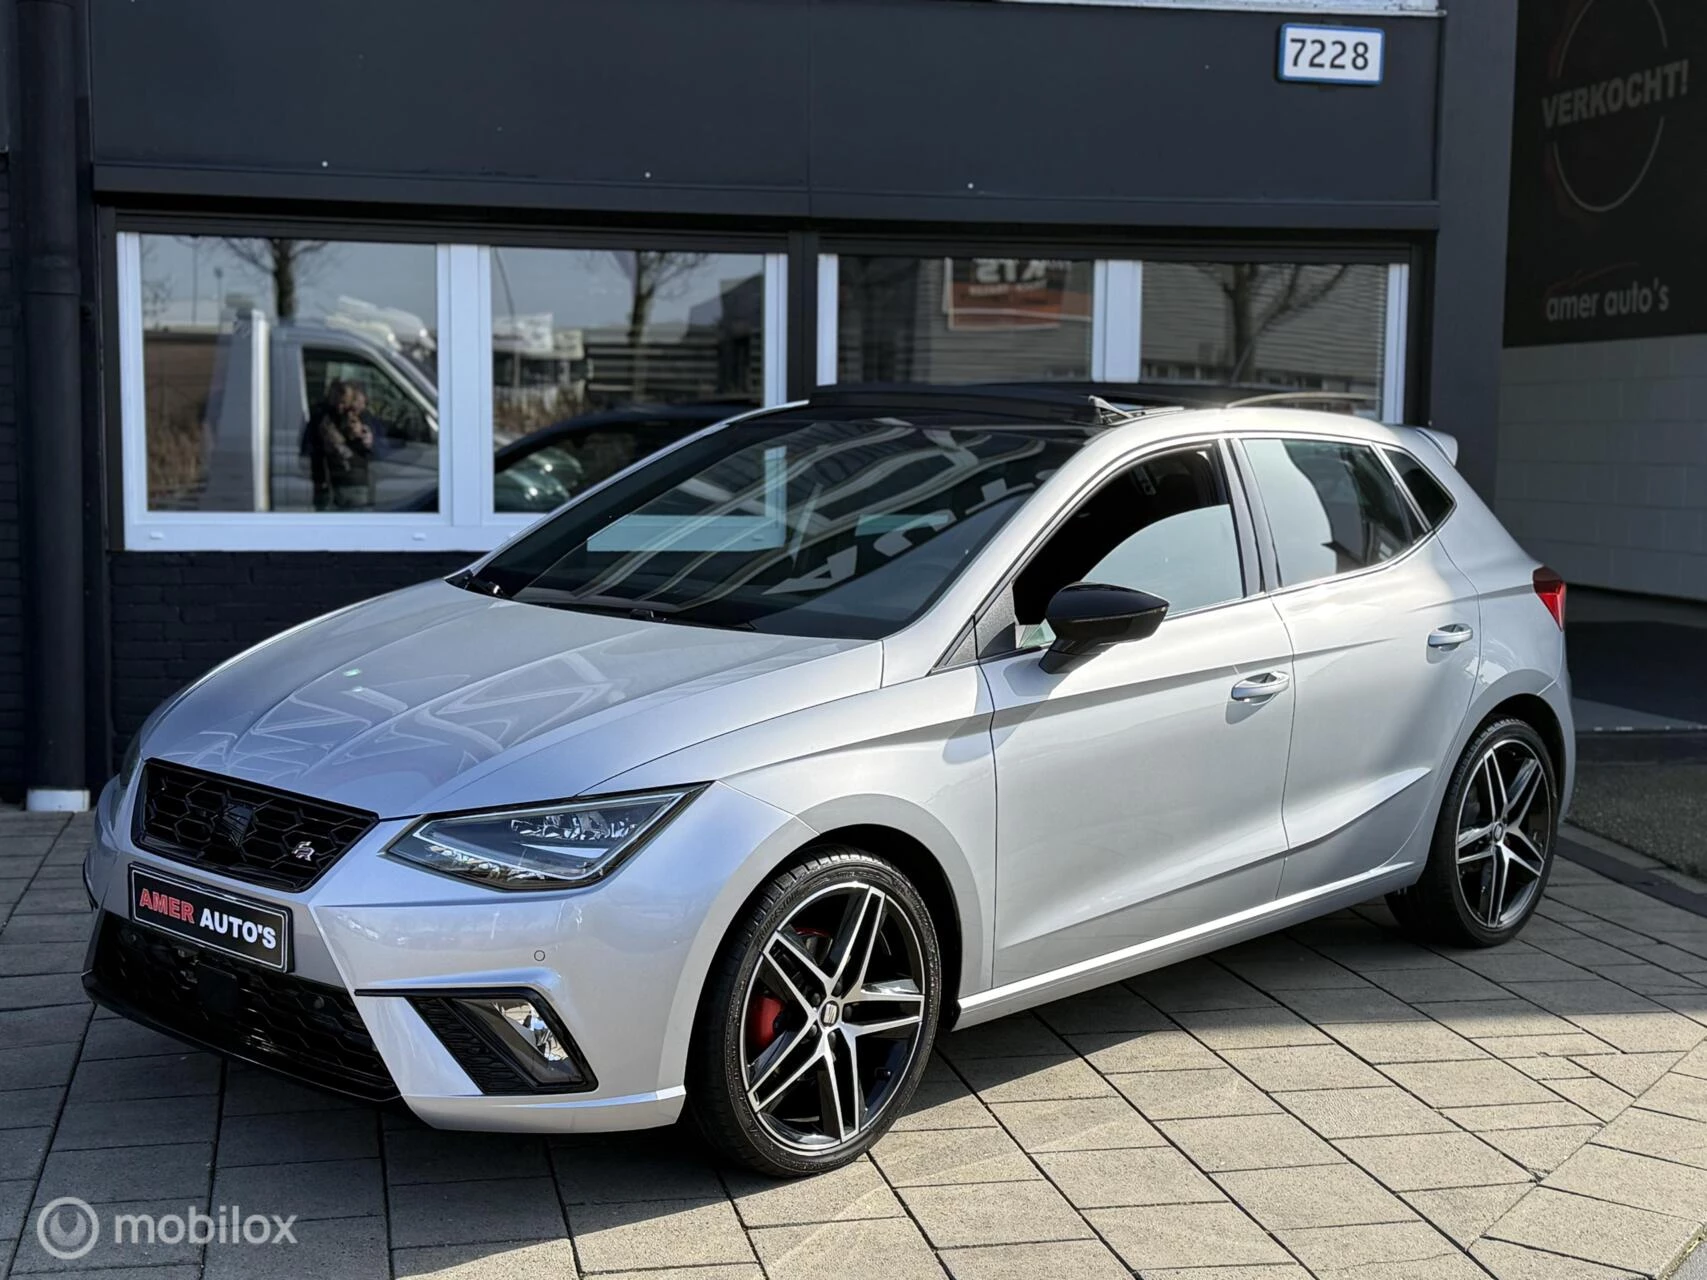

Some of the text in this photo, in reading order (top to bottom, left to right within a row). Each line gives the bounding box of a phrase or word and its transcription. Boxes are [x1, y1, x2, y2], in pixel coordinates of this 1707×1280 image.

[1289, 37, 1369, 71] 7228
[1541, 58, 1690, 129] VERKOCHT!
[1546, 277, 1670, 322] amer auto's
[139, 887, 277, 950] AMER AUTO'S
